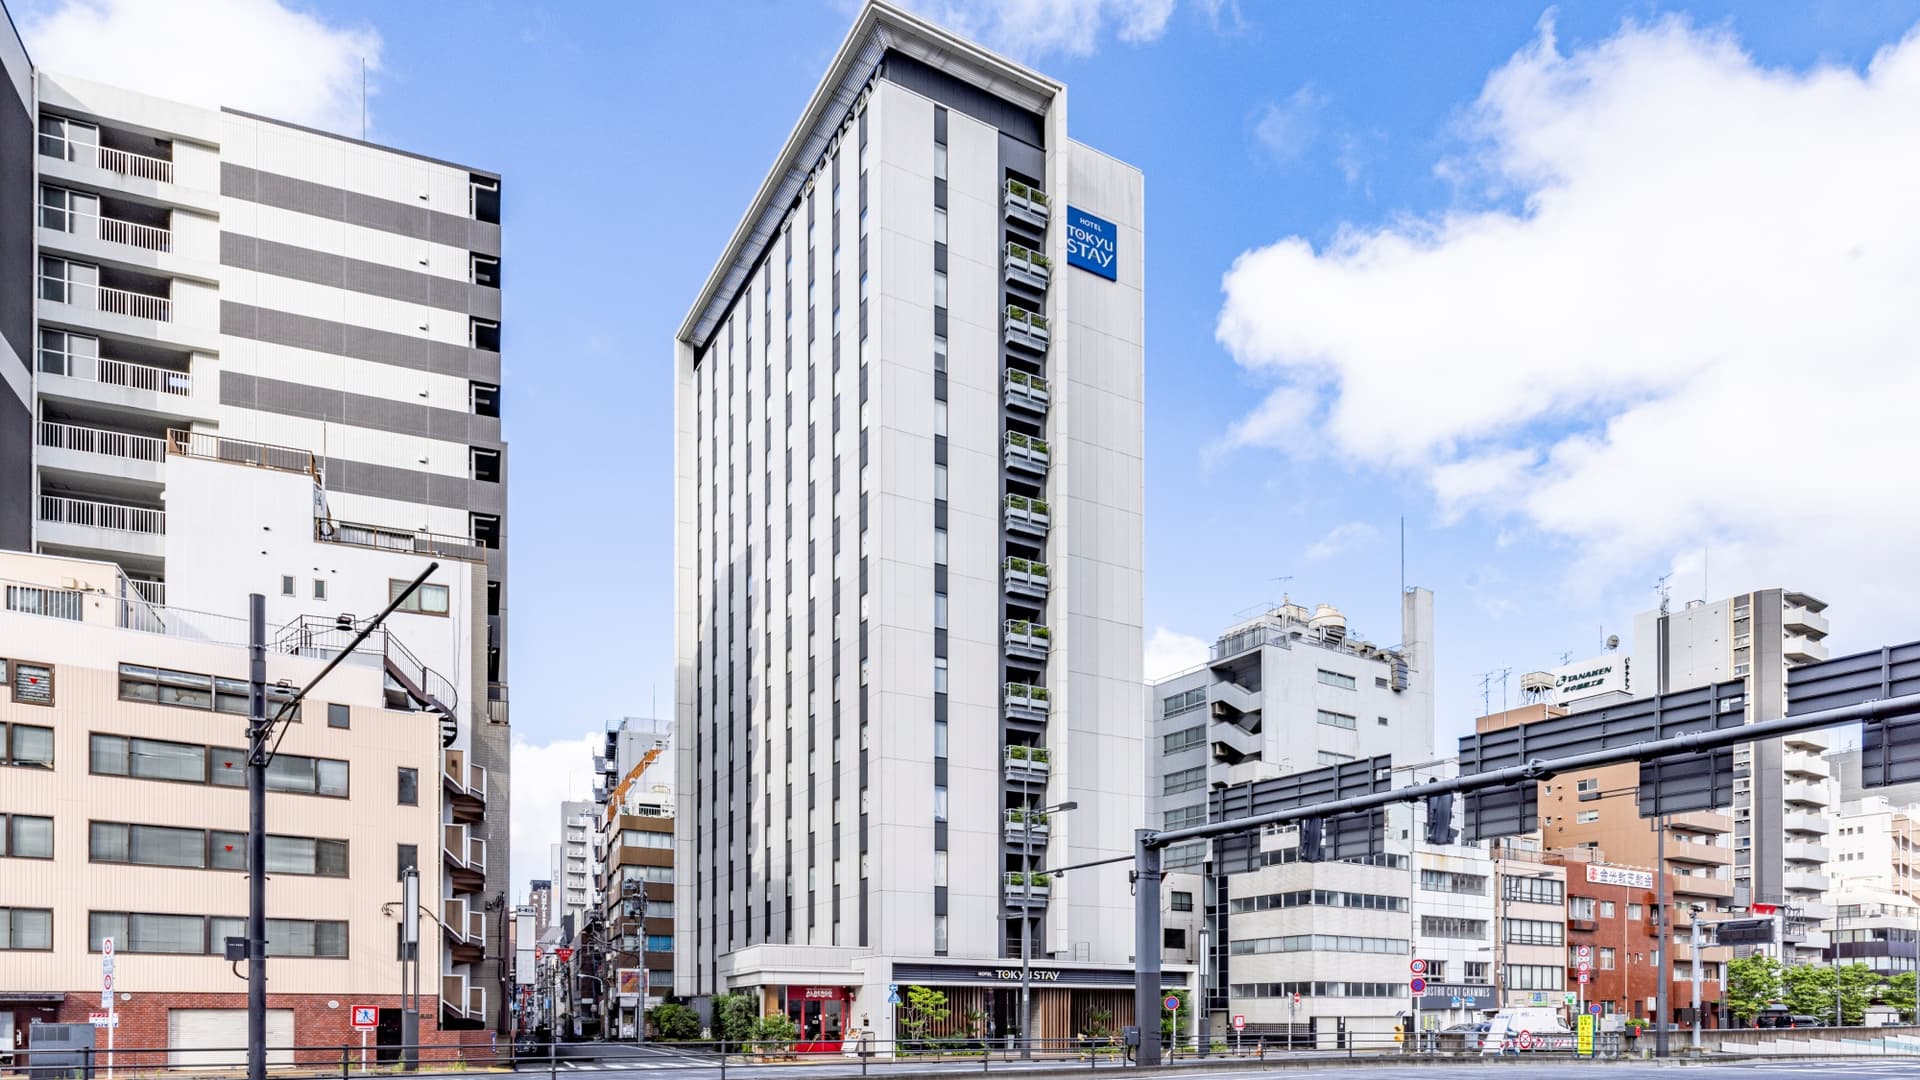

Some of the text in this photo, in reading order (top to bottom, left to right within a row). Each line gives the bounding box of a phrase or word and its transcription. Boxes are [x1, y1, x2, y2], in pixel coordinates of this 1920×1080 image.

[1080, 217, 1102, 232] HOTEL
[1067, 224, 1113, 252] TOKYU
[1067, 238, 1114, 268] STAY
[1568, 666, 1612, 683] TANAKEN
[1033, 970, 1060, 981] STAY
